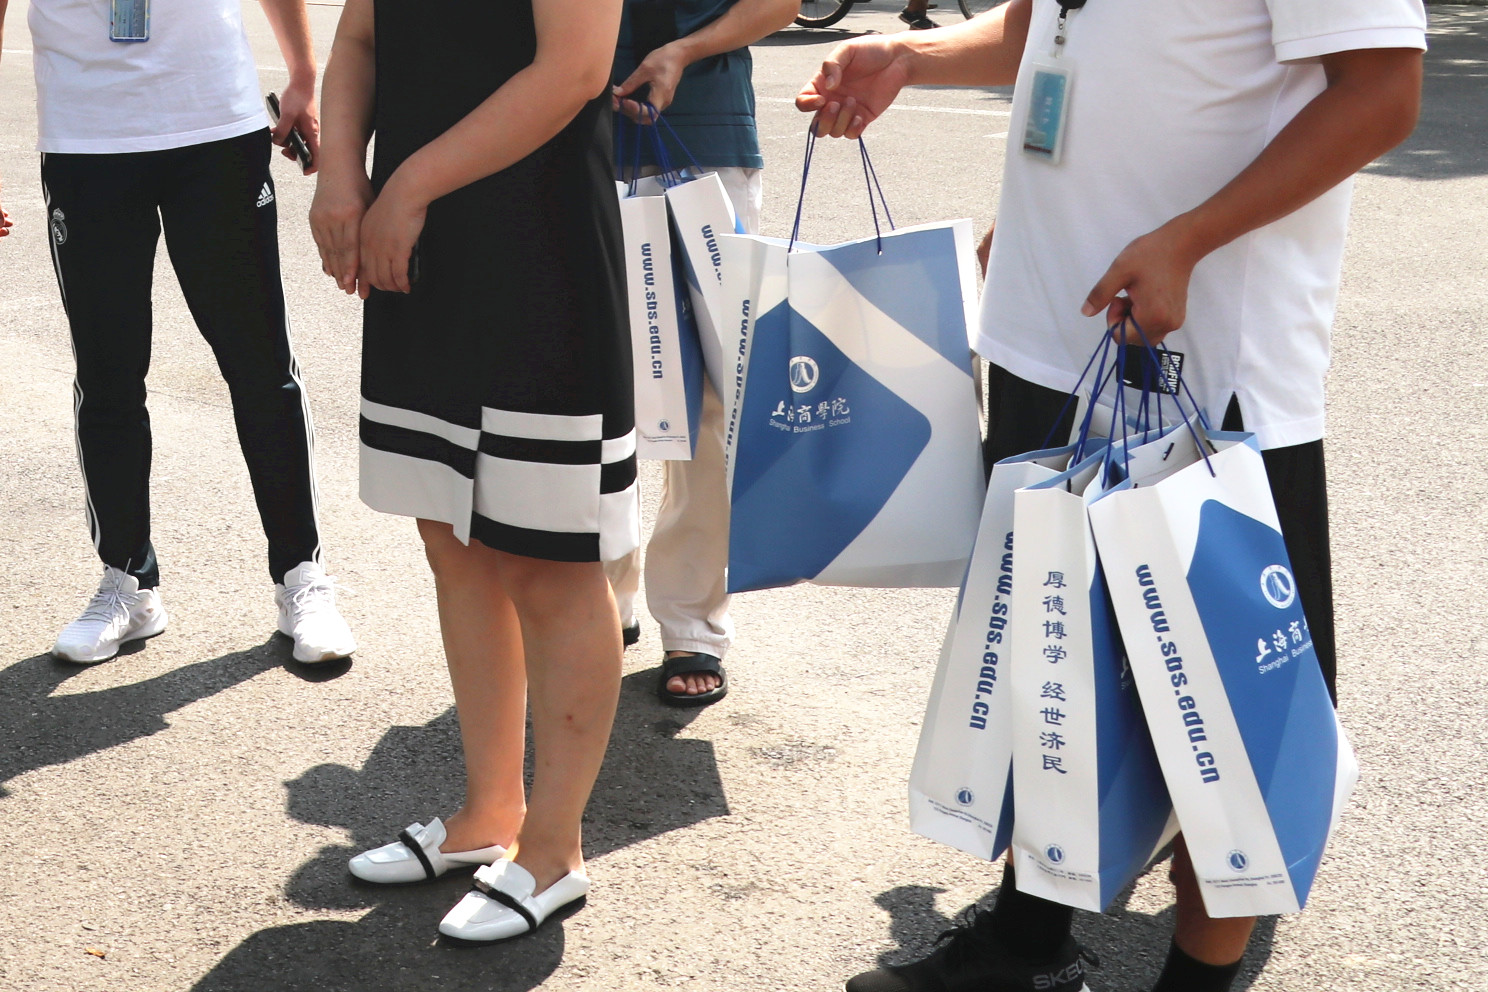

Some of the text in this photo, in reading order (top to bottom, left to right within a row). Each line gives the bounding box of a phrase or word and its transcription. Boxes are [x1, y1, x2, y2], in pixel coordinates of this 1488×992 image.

[256, 193, 275, 208] adidas
[640, 242, 664, 379] www.sbs.edu.cn
[793, 423, 825, 433] Business
[828, 416, 851, 427] School
[1039, 570, 1068, 775] 厚德博学 经世济民
[1134, 563, 1221, 785] www.sbs.edu.cn
[1258, 654, 1289, 674] Shanghai
